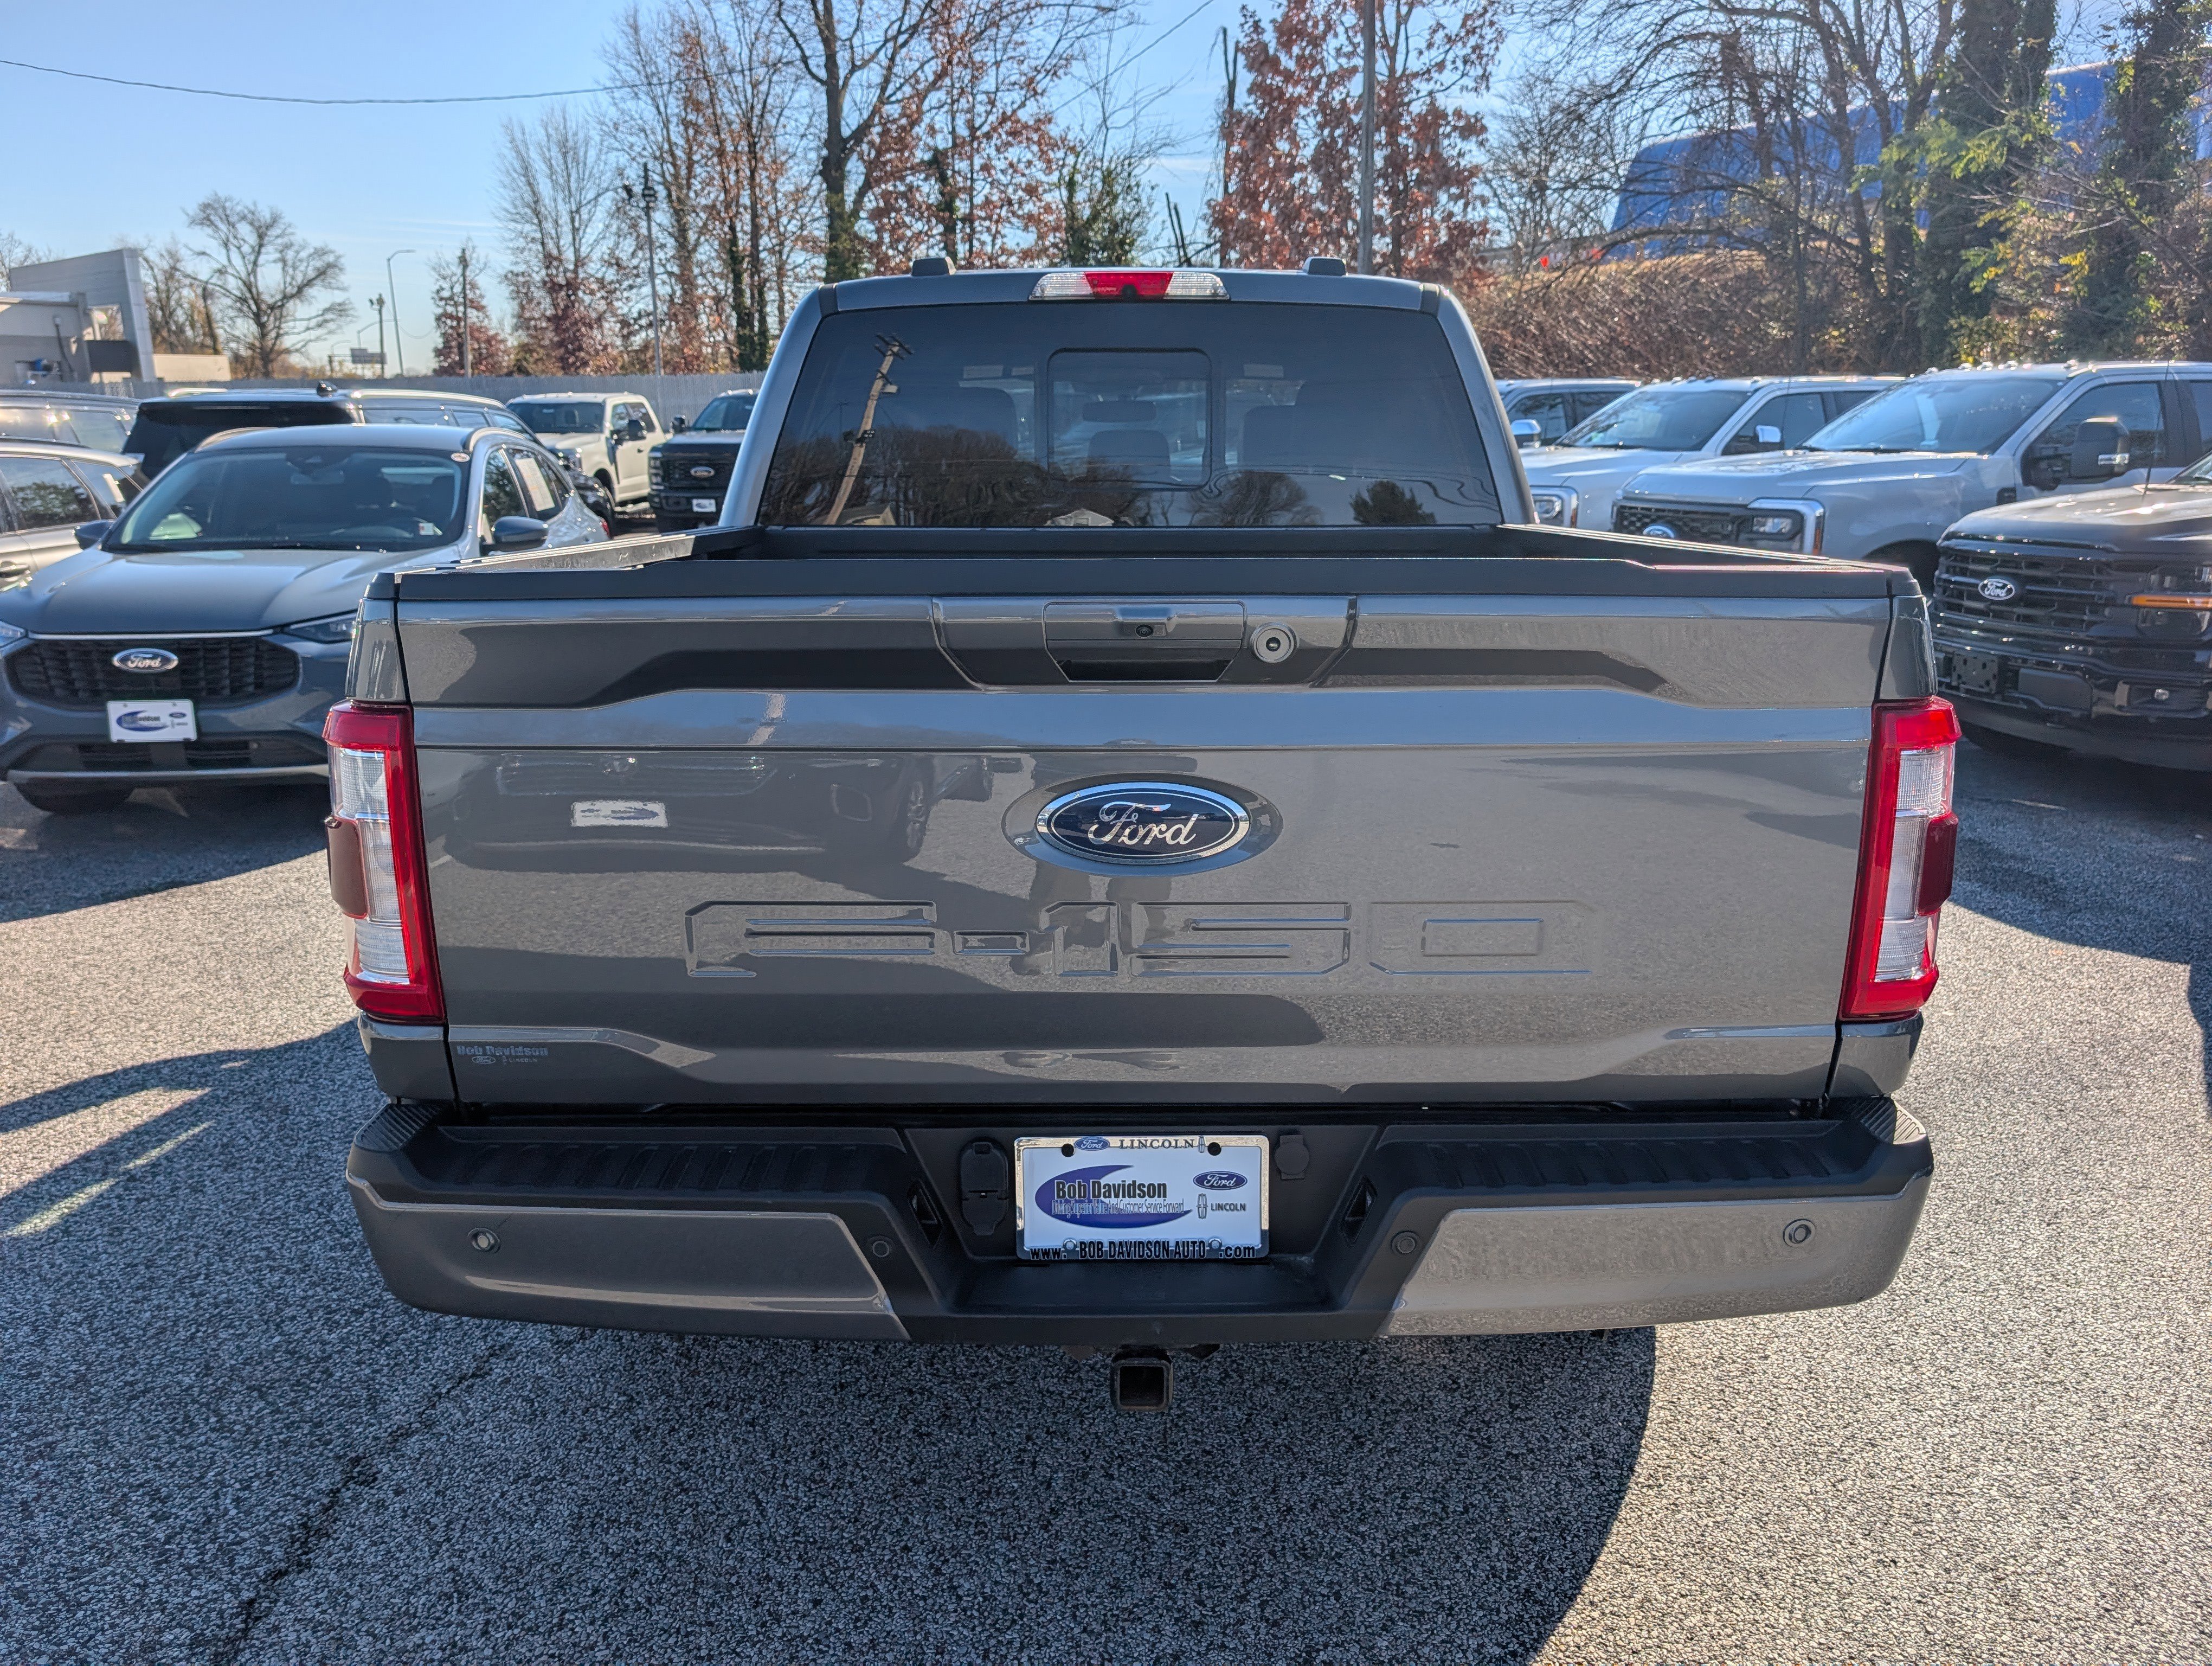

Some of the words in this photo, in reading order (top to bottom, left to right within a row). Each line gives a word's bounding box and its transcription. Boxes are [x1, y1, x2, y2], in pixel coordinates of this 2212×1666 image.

[1985, 581, 2008, 597] Ford
[127, 653, 162, 668] Ford
[1087, 801, 1200, 845] Ford
[685, 900, 1594, 979] F-150
[456, 1045, 483, 1055] Bob
[485, 1046, 549, 1056] Davidson
[1081, 1139, 1104, 1150] Ford
[1118, 1139, 1195, 1149] LINCOLN
[1203, 1173, 1237, 1188] Ford
[1055, 1180, 1087, 1199] Bob
[1091, 1180, 1168, 1199] Davidson
[1108, 1200, 1118, 1214] And
[1119, 1200, 1143, 1214] Customer
[1144, 1199, 1162, 1214] Service
[1163, 1199, 1184, 1213] Forward
[1211, 1202, 1246, 1212] LINCOLN
[1031, 1248, 1066, 1260] www.
[1079, 1241, 1104, 1259] BOB
[1108, 1240, 1169, 1259] DAVIDSON
[1173, 1240, 1207, 1258] AUTO
[1219, 1245, 1256, 1258] .com
